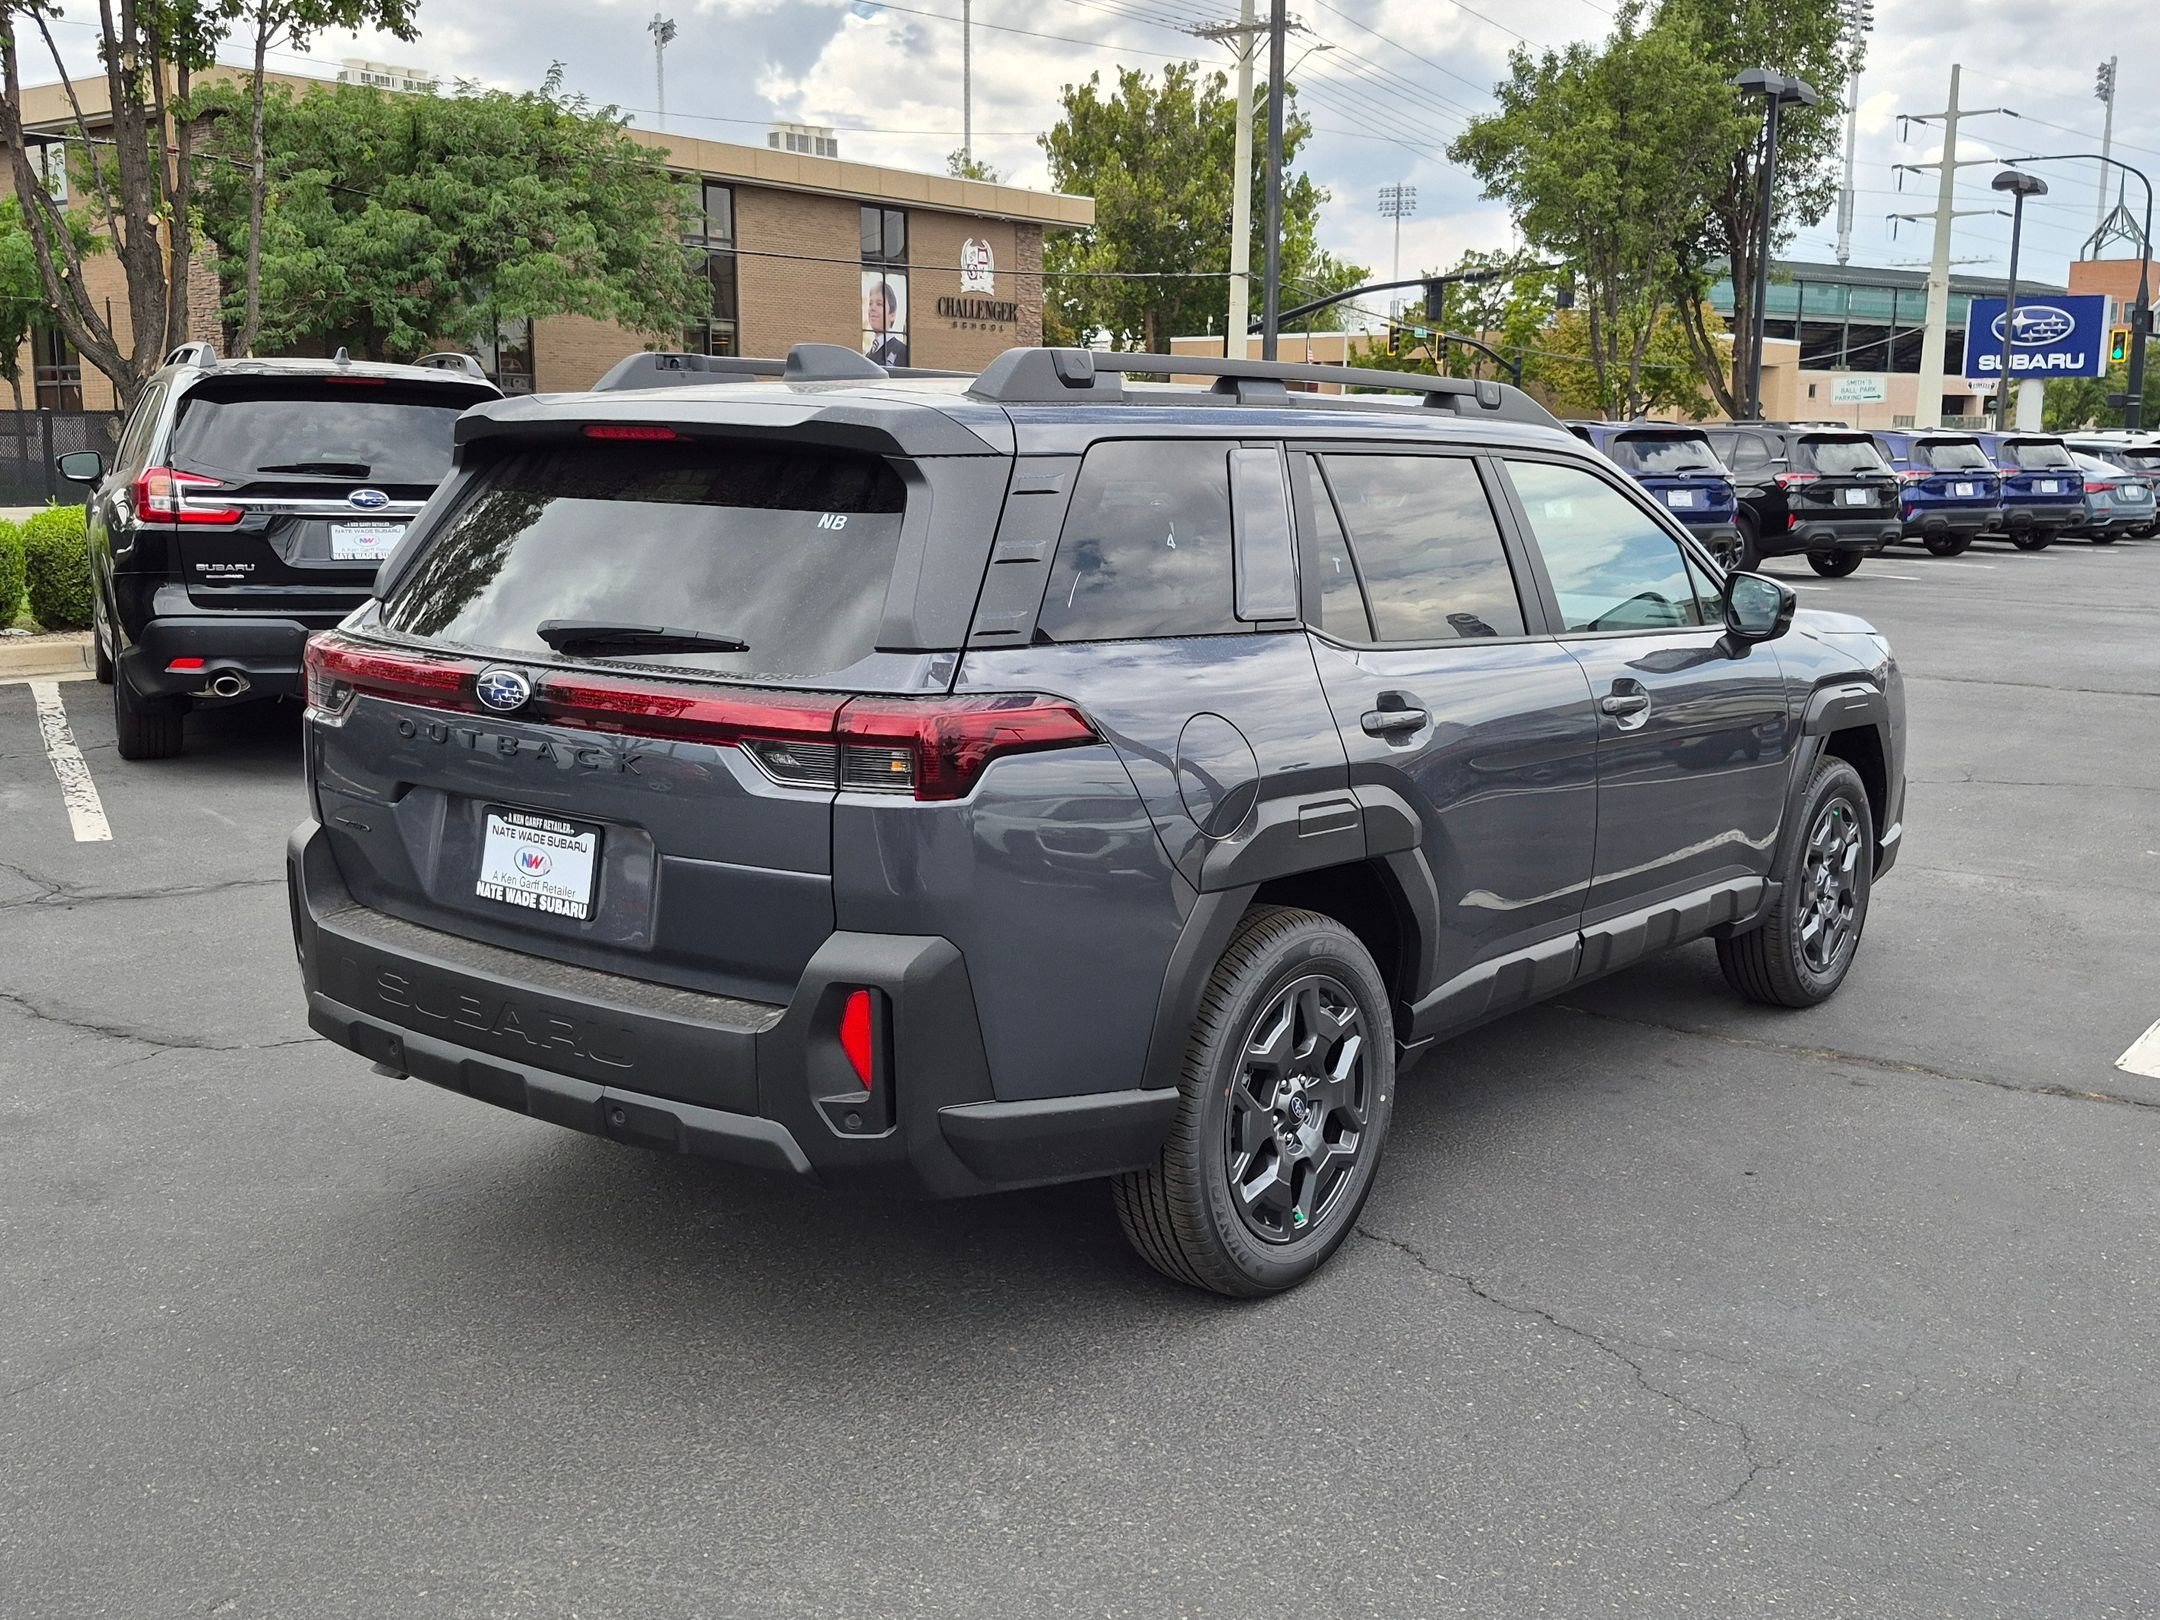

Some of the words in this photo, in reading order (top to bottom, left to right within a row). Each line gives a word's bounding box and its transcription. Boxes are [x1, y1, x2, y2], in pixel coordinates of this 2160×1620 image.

[938, 296, 1019, 322] CHALLENGER
[951, 321, 1004, 332] SCHOOL
[1978, 352, 2085, 371] SUBARU
[817, 513, 848, 530] NB
[195, 563, 256, 572] SUBARU
[399, 718, 641, 775] OUTBACK
[508, 813, 515, 823] A
[513, 813, 527, 826] KEN
[525, 816, 543, 829] GARFF
[543, 820, 571, 833] RETAILER
[492, 824, 516, 839] NATE
[518, 828, 546, 845] WADE
[546, 835, 588, 853] SUBARU
[522, 852, 544, 869] NW
[492, 870, 499, 881] A
[501, 872, 518, 885] Ken
[519, 876, 540, 890] Garff
[542, 881, 577, 899] Retailer
[476, 881, 504, 900] NATE
[505, 886, 538, 909] WADE
[539, 894, 588, 920] SUBARU
[377, 970, 634, 1068] SUBARU
